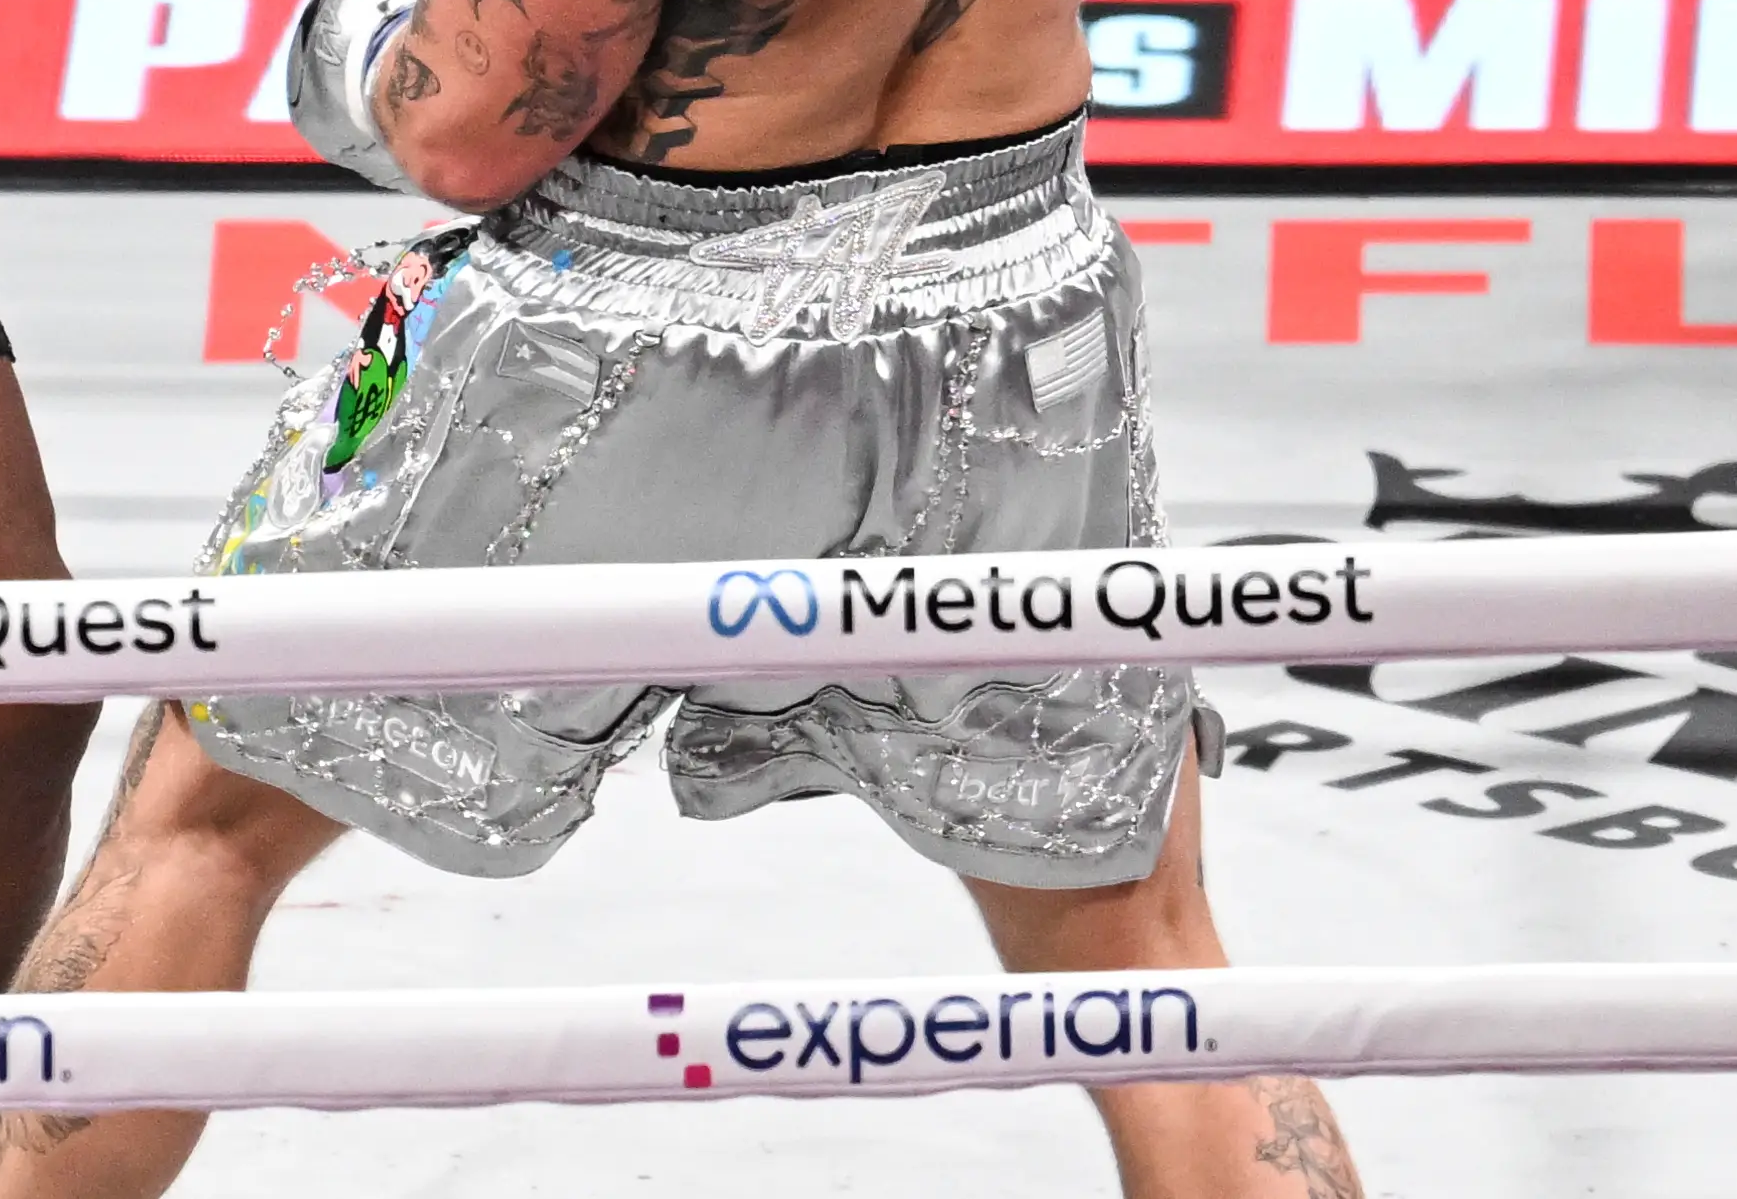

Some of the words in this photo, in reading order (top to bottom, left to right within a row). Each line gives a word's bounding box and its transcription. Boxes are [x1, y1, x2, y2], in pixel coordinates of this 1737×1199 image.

[841, 565, 1074, 634] Meta
[1095, 556, 1375, 640] Quest
[726, 982, 1198, 1084] experian
